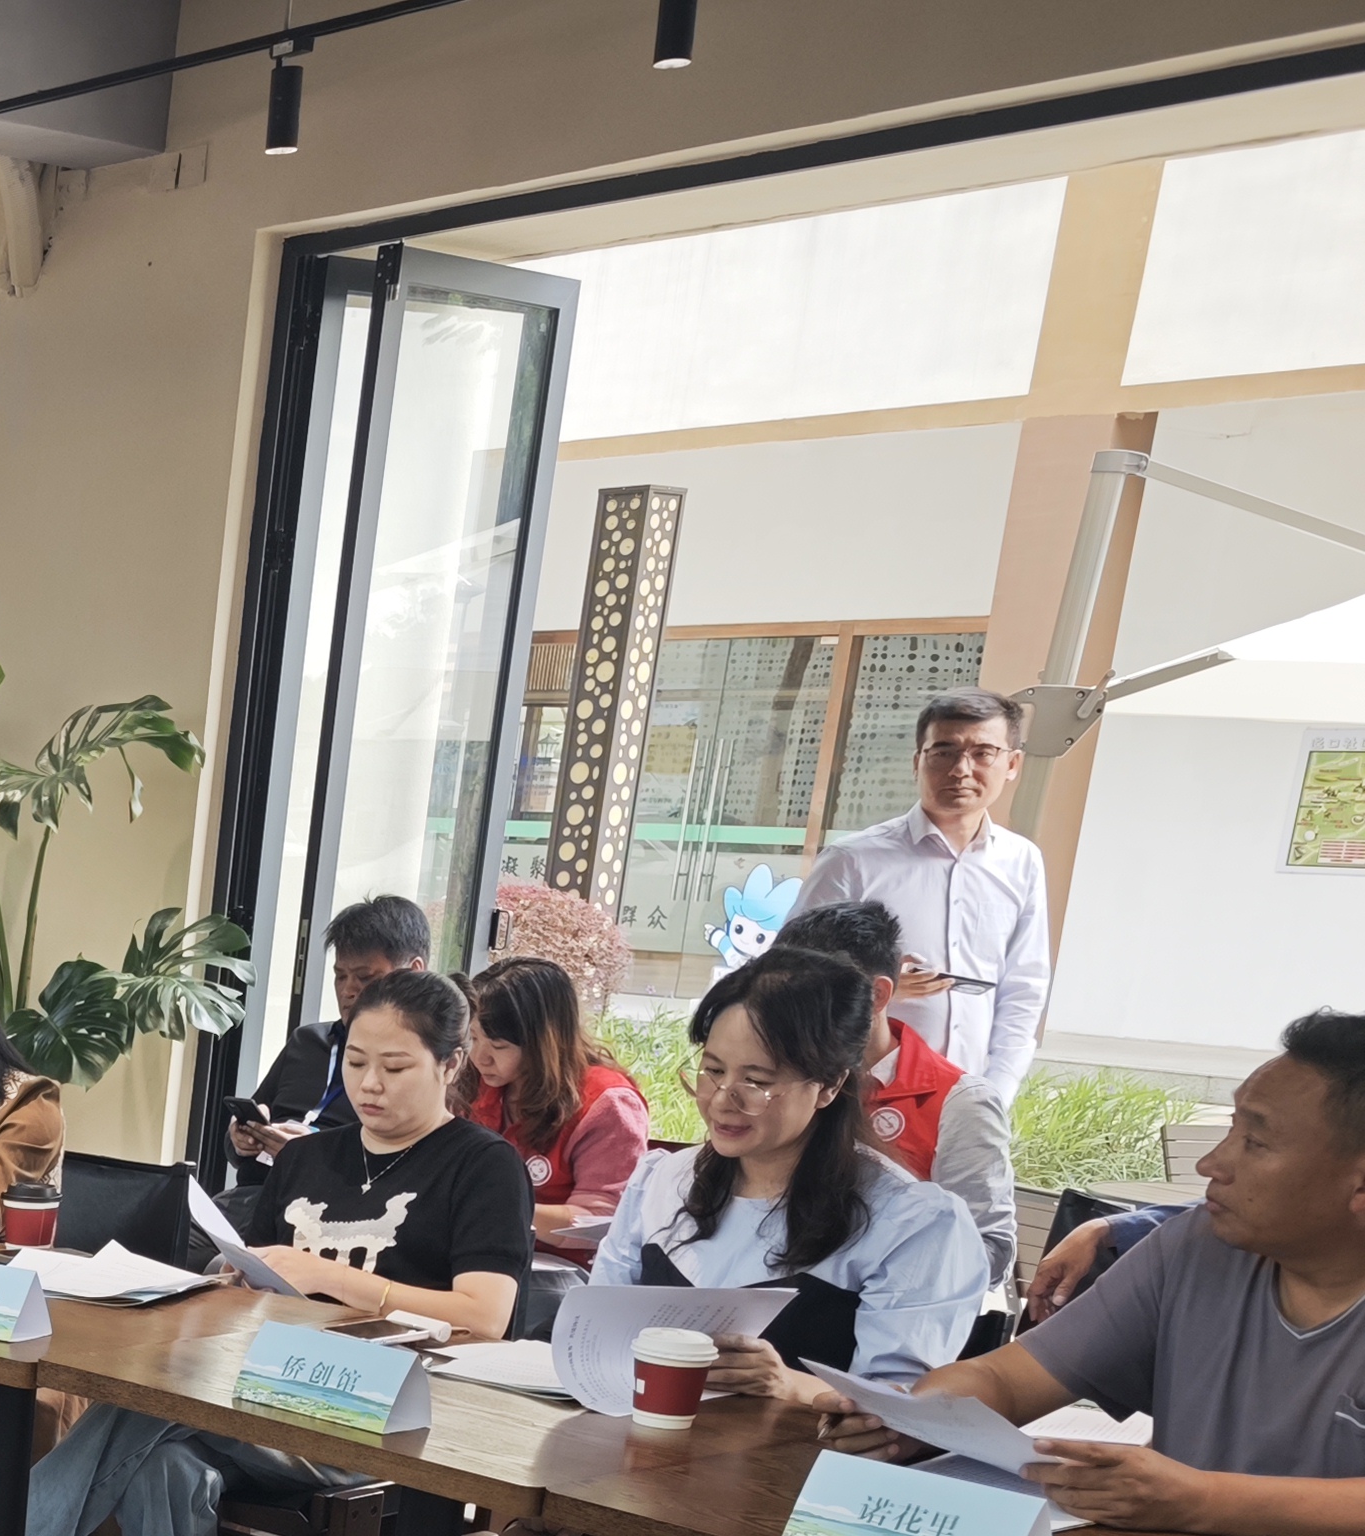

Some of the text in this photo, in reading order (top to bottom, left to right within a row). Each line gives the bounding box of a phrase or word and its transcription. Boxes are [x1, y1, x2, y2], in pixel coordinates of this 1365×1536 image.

[621, 905, 667, 931] 群众
[280, 1354, 363, 1393] 侨创馆
